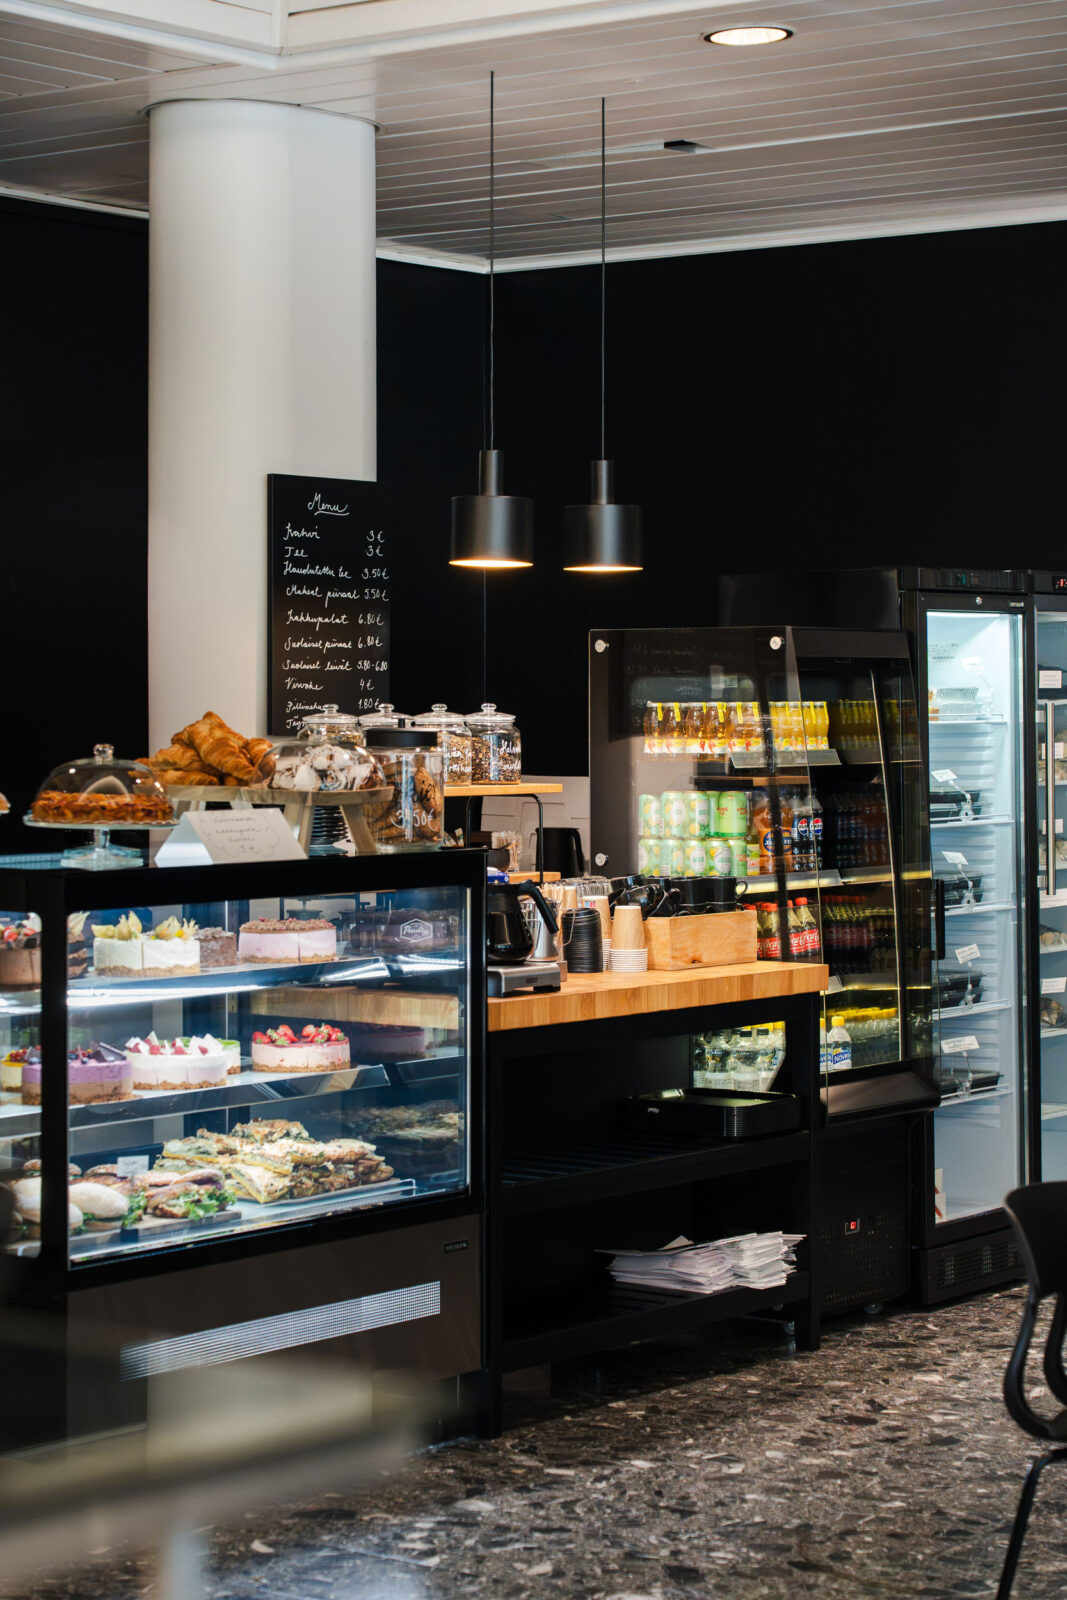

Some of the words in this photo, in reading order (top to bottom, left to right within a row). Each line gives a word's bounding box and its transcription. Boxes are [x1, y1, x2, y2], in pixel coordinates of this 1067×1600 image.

[307, 492, 348, 513] Menu
[283, 522, 320, 541] Kahvi
[284, 546, 309, 558] Tee
[338, 566, 352, 579] tee
[286, 608, 350, 632] Kakkupalat
[284, 636, 323, 651] Suolaiset
[282, 656, 321, 670] Suolaiset
